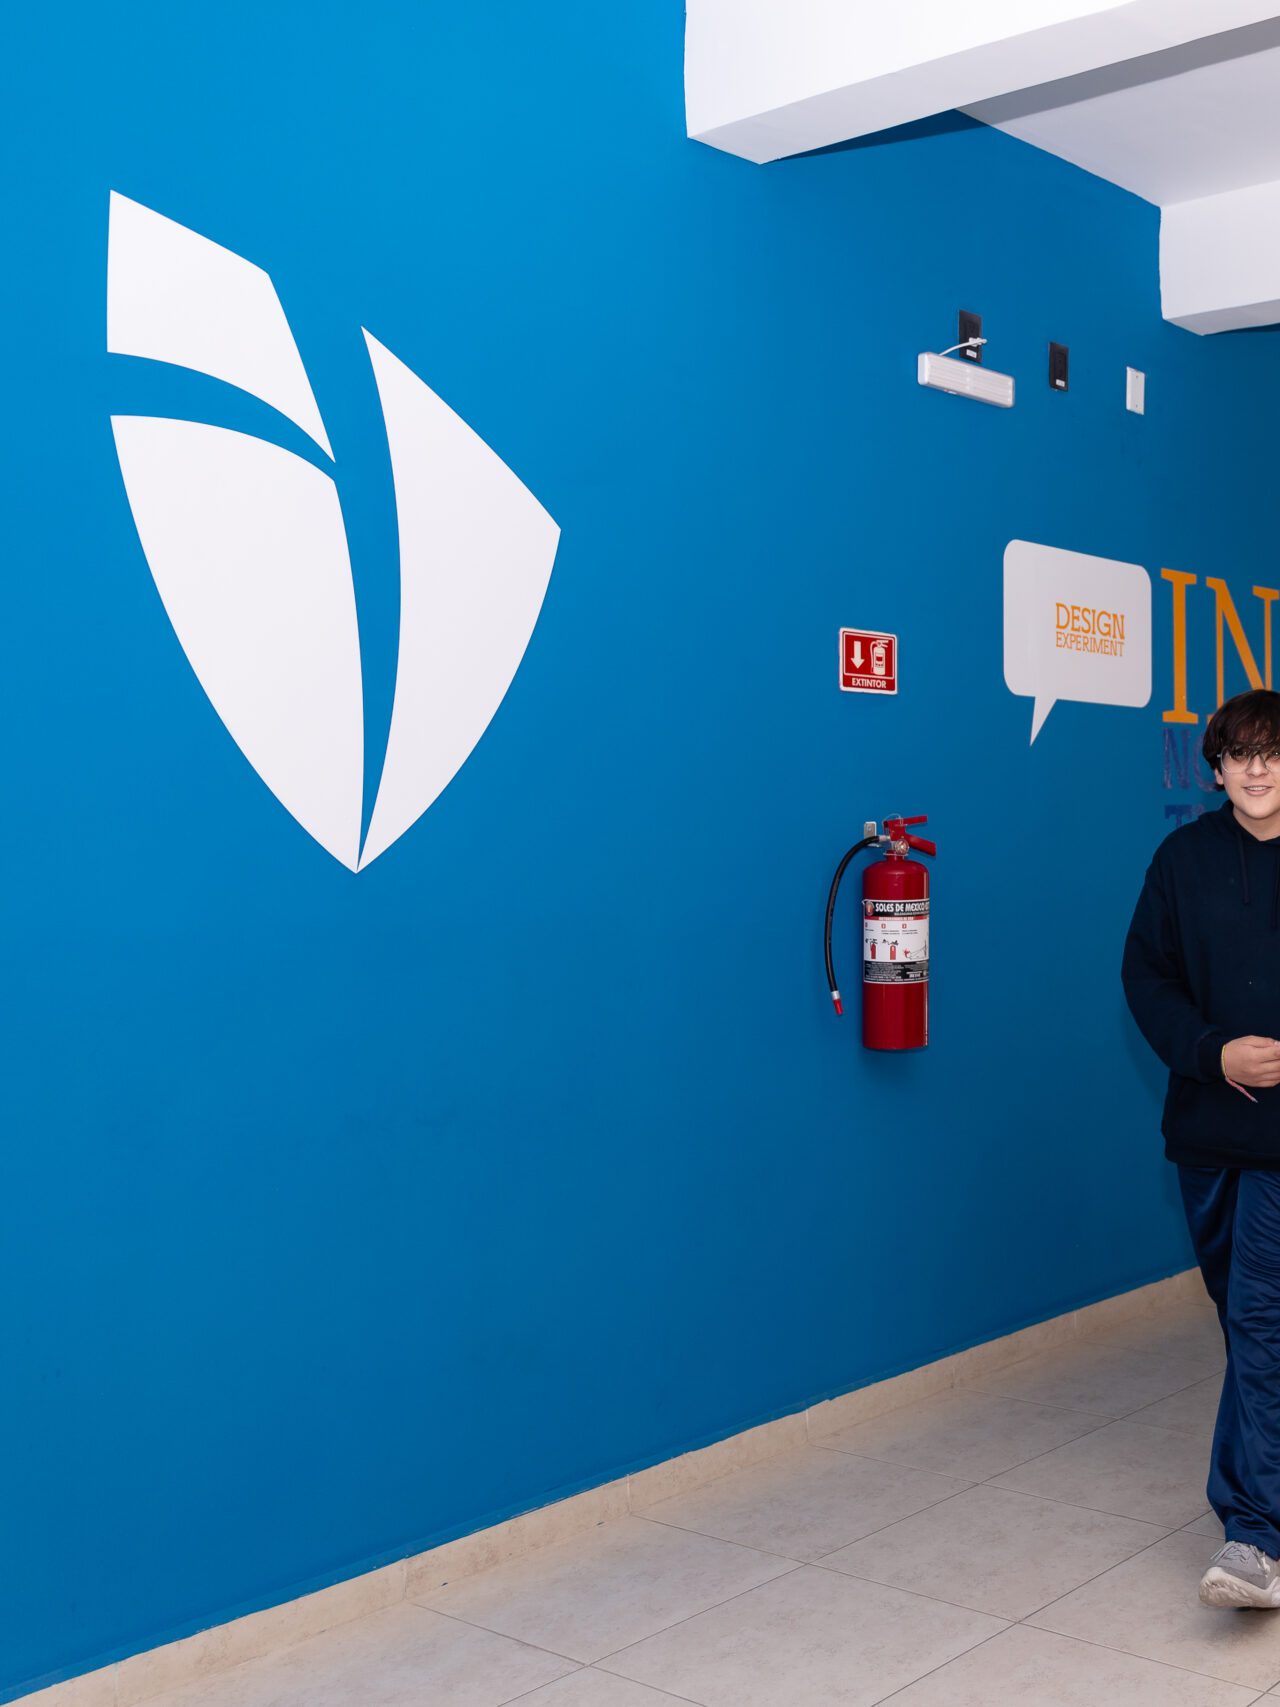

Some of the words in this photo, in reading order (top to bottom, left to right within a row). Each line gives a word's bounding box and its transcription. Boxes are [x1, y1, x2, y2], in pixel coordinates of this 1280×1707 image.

[1055, 602, 1125, 640] DESIGN
[1055, 631, 1125, 657] EXPERIMENT
[1161, 567, 1280, 724] IN
[851, 677, 887, 689] EXTINTOR
[875, 903, 894, 912] SOLES
[895, 903, 904, 912] DE
